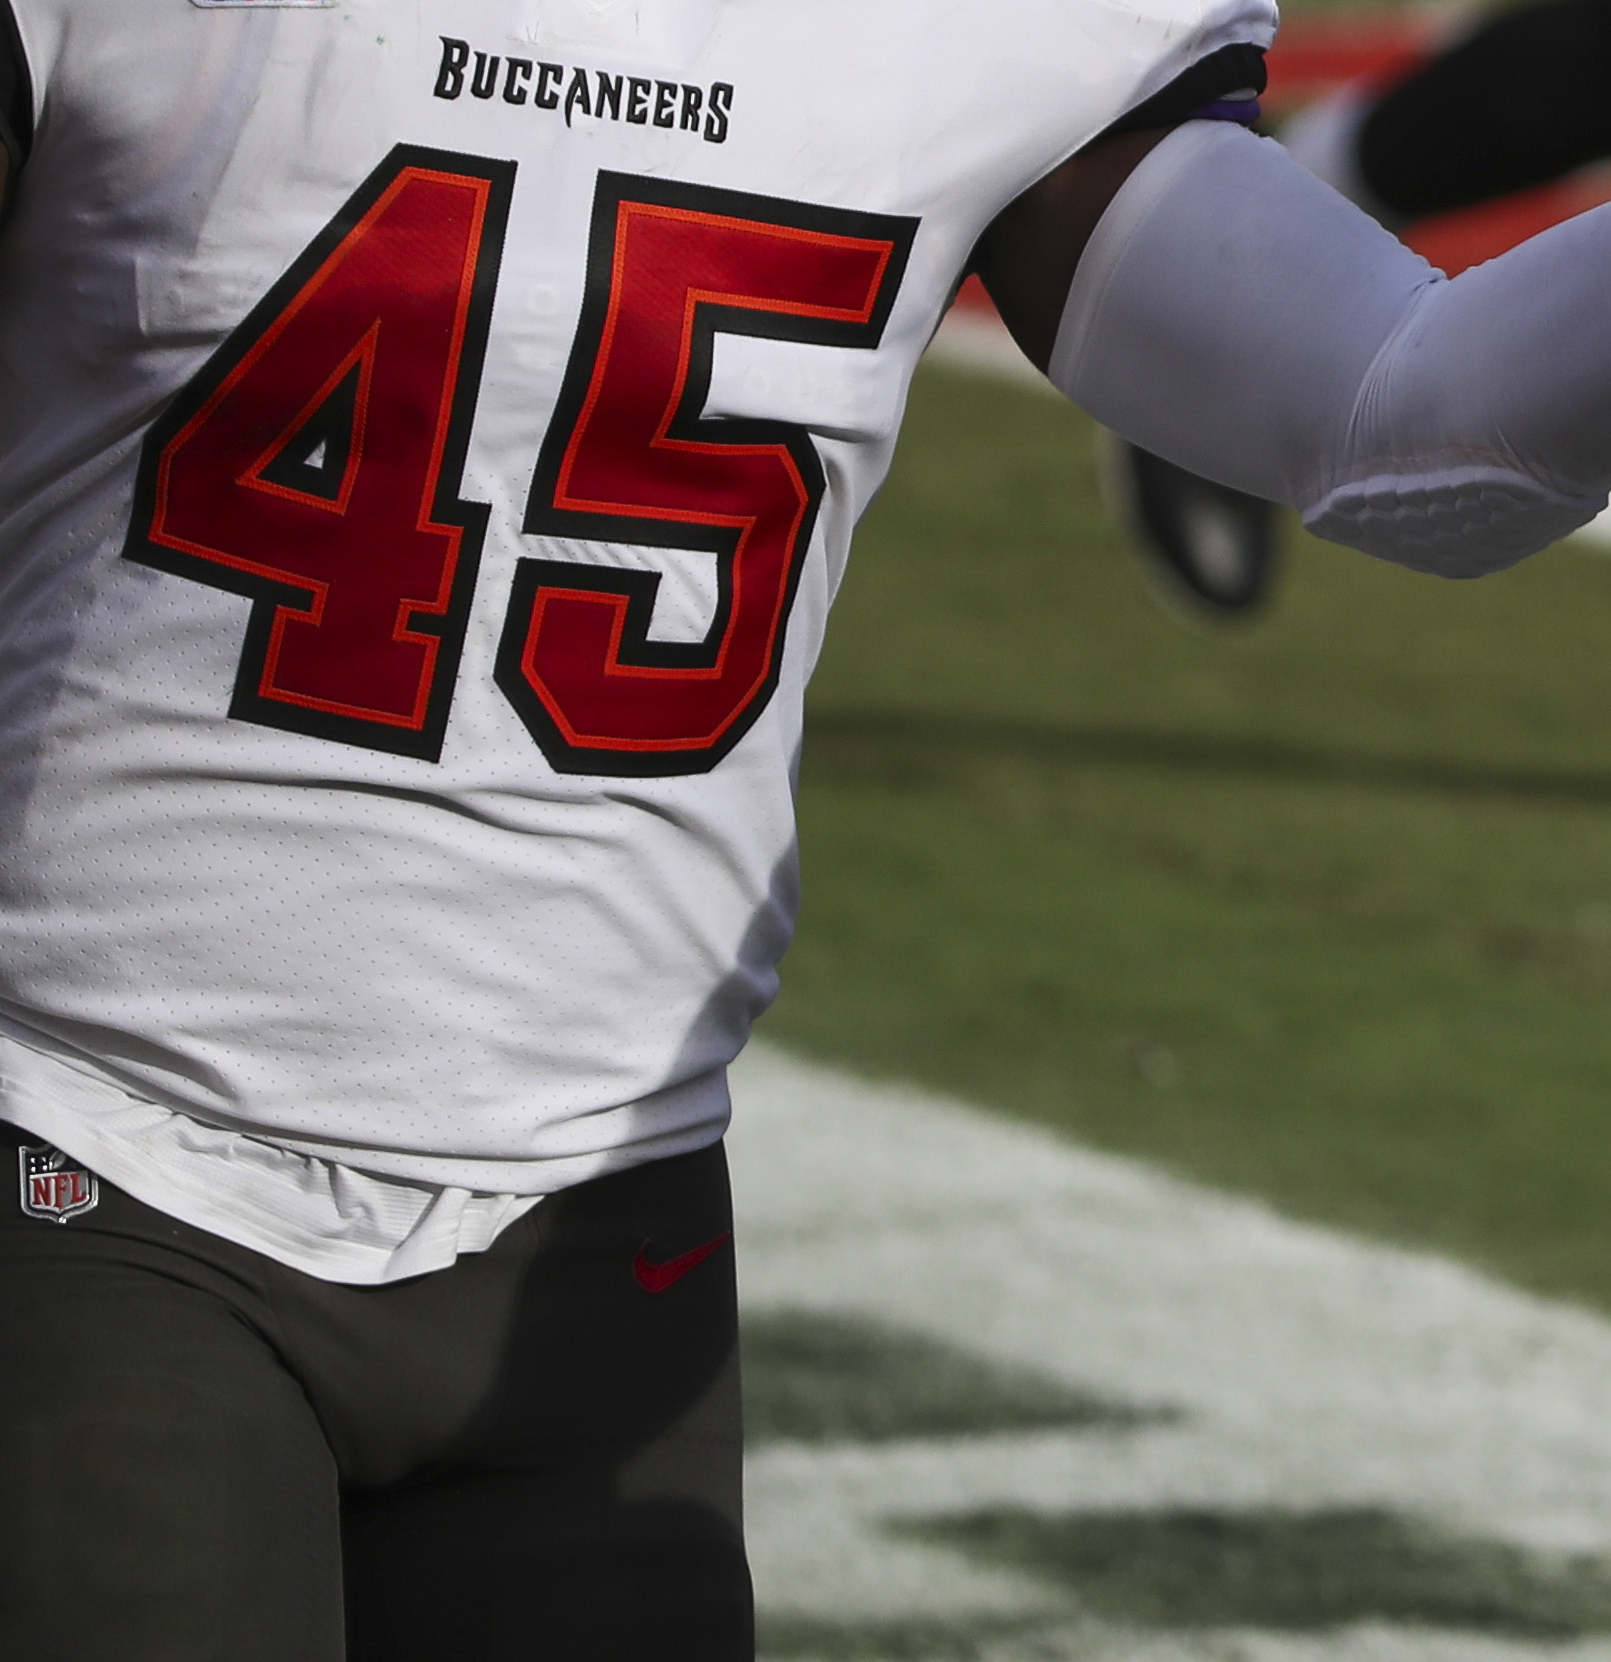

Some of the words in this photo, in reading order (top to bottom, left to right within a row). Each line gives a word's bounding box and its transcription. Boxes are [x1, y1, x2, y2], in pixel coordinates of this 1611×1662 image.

[433, 35, 734, 143] BUCCANEERS
[122, 142, 922, 778] 45
[30, 1174, 87, 1208] NFL
